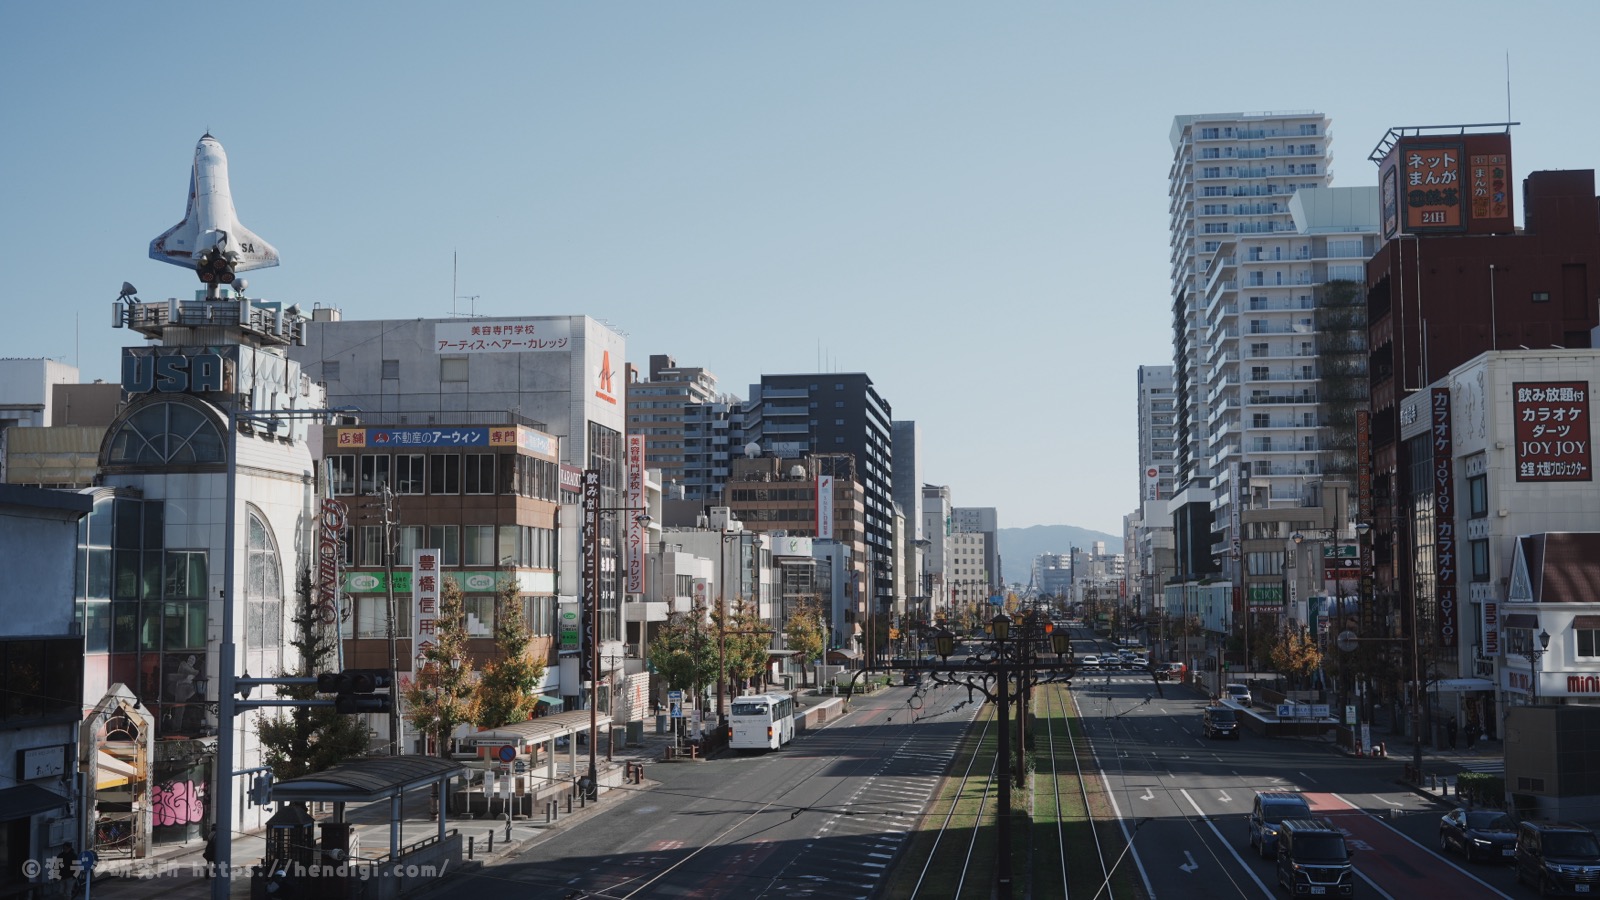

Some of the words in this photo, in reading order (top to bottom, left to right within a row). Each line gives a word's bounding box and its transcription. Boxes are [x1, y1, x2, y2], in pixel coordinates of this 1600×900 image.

[1408, 153, 1456, 169] ネット
[1409, 169, 1457, 186] まんが
[1475, 168, 1488, 197] まんが
[1492, 167, 1506, 217] カラオケ
[1423, 212, 1445, 223] 24H
[239, 243, 254, 253] SA
[471, 325, 535, 337] 美容専門学校
[438, 337, 568, 352] アーティス・ヘアー・カレッジ
[123, 353, 223, 393] USA
[1518, 387, 1585, 403] 飲み放題付
[1434, 392, 1450, 451] カラオケ
[1522, 407, 1582, 422] カラオケ
[340, 432, 364, 444] 店舗
[392, 431, 481, 444] 不動産のアーウィン
[492, 430, 515, 443] 専門
[1532, 424, 1571, 438] ダーツ
[1521, 441, 1553, 457] JOY
[1555, 440, 1586, 457] JOY
[629, 437, 641, 490] 美容専門学校
[1520, 462, 1535, 477] 全室
[1536, 461, 1587, 477] 大型プロジェクター
[1438, 521, 1453, 581] カラオケ
[354, 577, 375, 587] Cast
[470, 577, 490, 587] Cast
[418, 555, 436, 654] 豊橋信用金
[1567, 676, 1600, 693] mini
